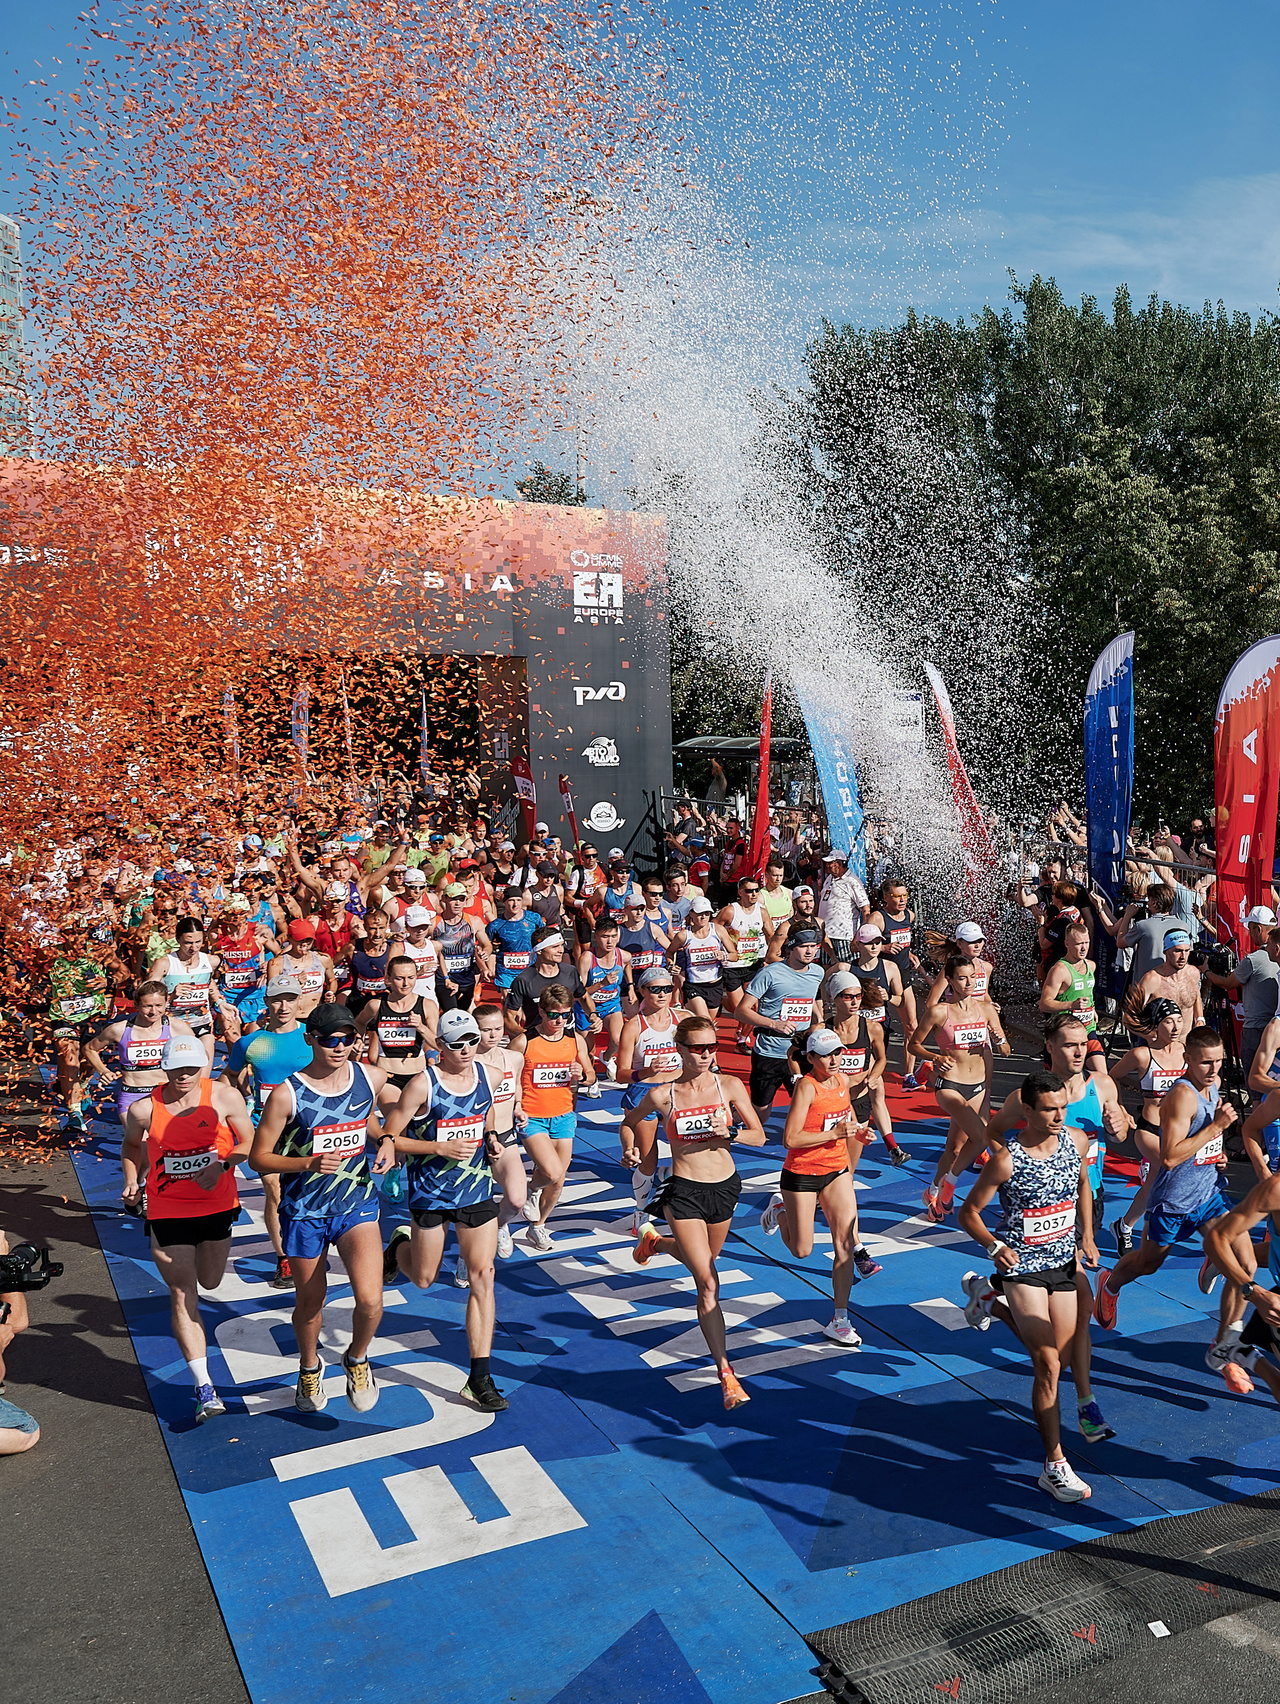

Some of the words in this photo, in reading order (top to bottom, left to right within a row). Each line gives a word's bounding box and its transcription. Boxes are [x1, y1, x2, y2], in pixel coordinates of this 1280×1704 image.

[376, 568, 515, 592] ASIA
[574, 608, 624, 617] EUROPE
[573, 616, 624, 625] ASIA
[581, 747, 608, 757] АВТО
[588, 754, 620, 764] РАДИО
[450, 960, 465, 968] 508
[507, 957, 525, 965] 2404
[68, 1000, 87, 1010] 232
[787, 1006, 808, 1014] 2475
[384, 1030, 410, 1039] 2041
[961, 1031, 983, 1041] 2034
[645, 1041, 677, 1050] RUSSI
[135, 1048, 163, 1058] 2501
[540, 1070, 567, 1081] 2043
[685, 1117, 711, 1131] 203
[447, 1128, 476, 1141] 2051
[323, 1133, 360, 1149] 2050
[340, 1148, 361, 1158] РОССИИ
[172, 1156, 211, 1171] 2049
[1033, 1216, 1067, 1232] 2037
[1029, 1235, 1049, 1243] КУБОК
